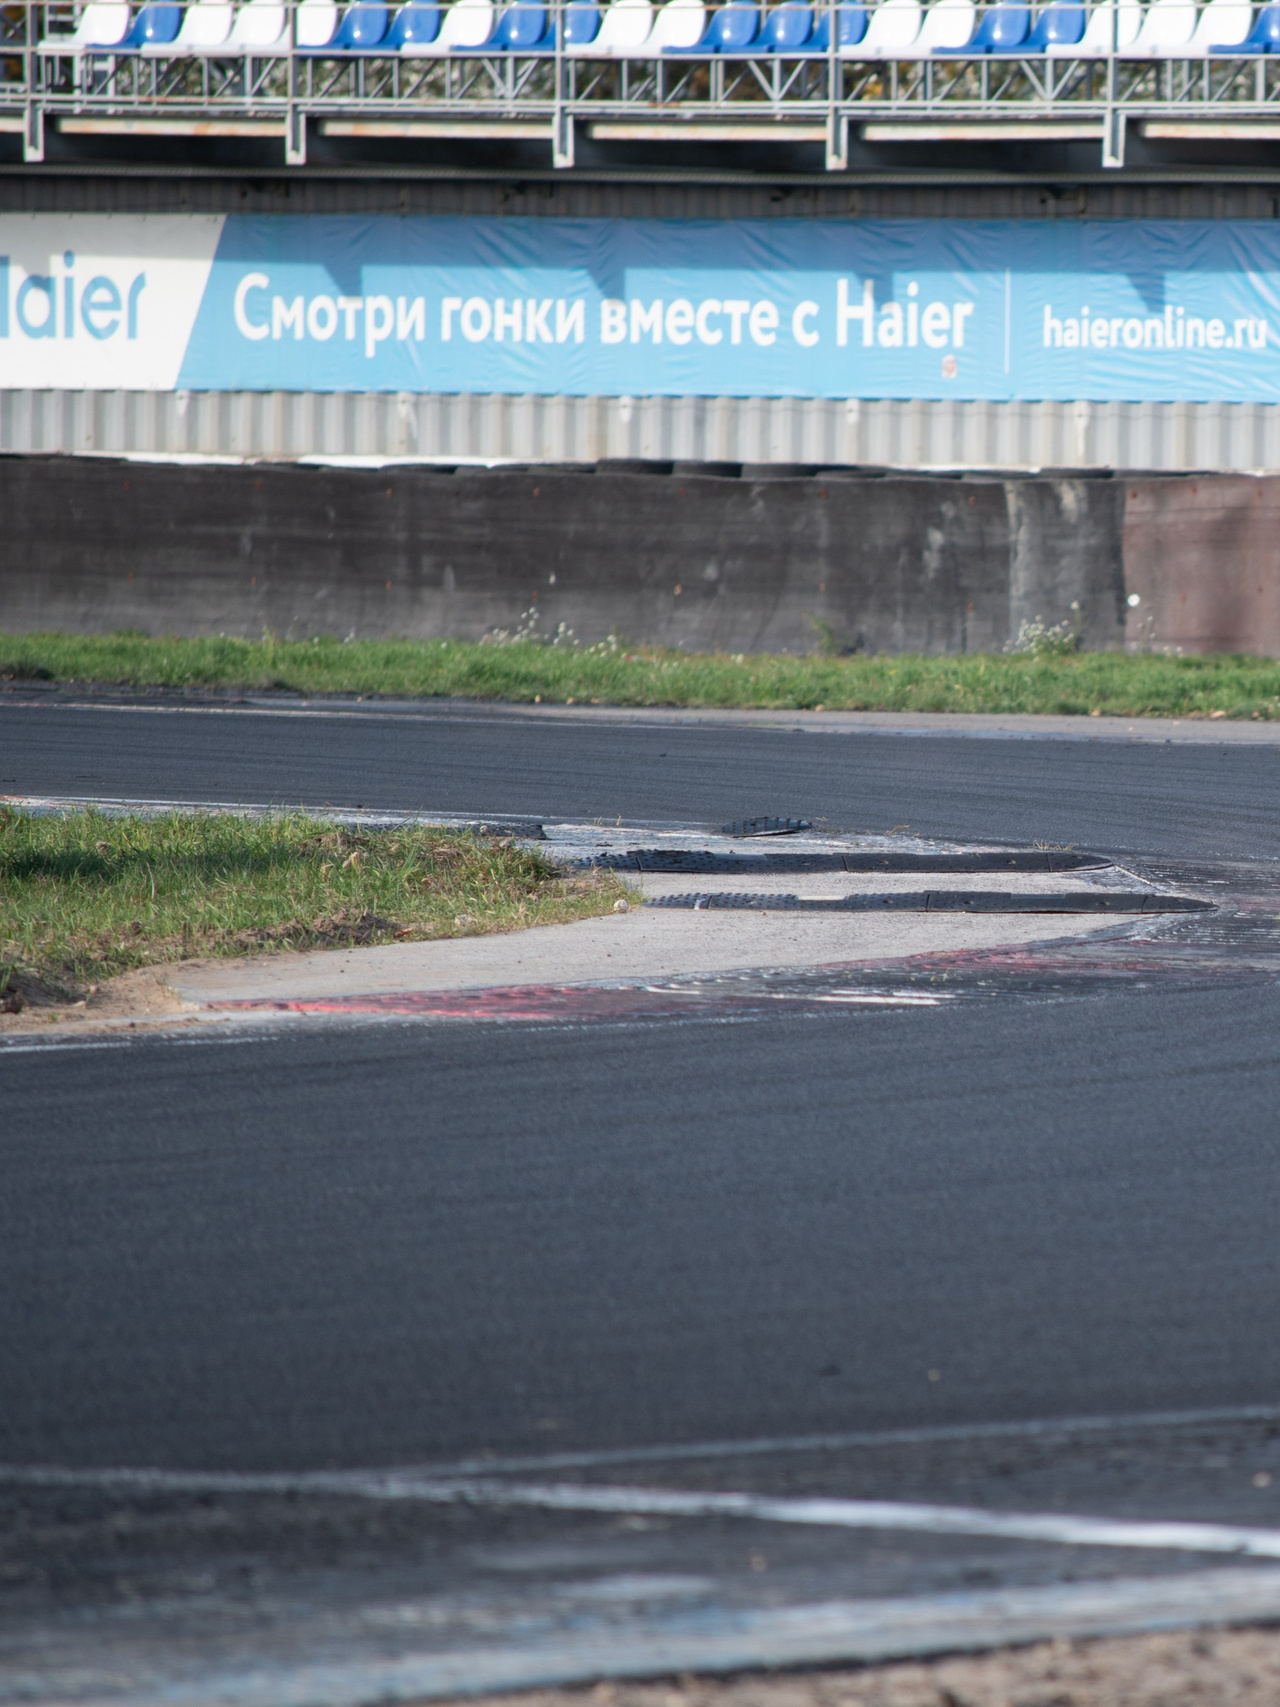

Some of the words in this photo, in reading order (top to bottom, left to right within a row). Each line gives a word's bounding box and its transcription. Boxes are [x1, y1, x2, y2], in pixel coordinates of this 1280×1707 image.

[0, 250, 147, 340] aier
[234, 272, 426, 358] Смотри
[441, 296, 586, 343] гонки
[600, 297, 780, 347] вместе
[791, 300, 820, 347] с
[835, 278, 974, 348] Haier
[1043, 305, 1268, 349] haieronline.ru
